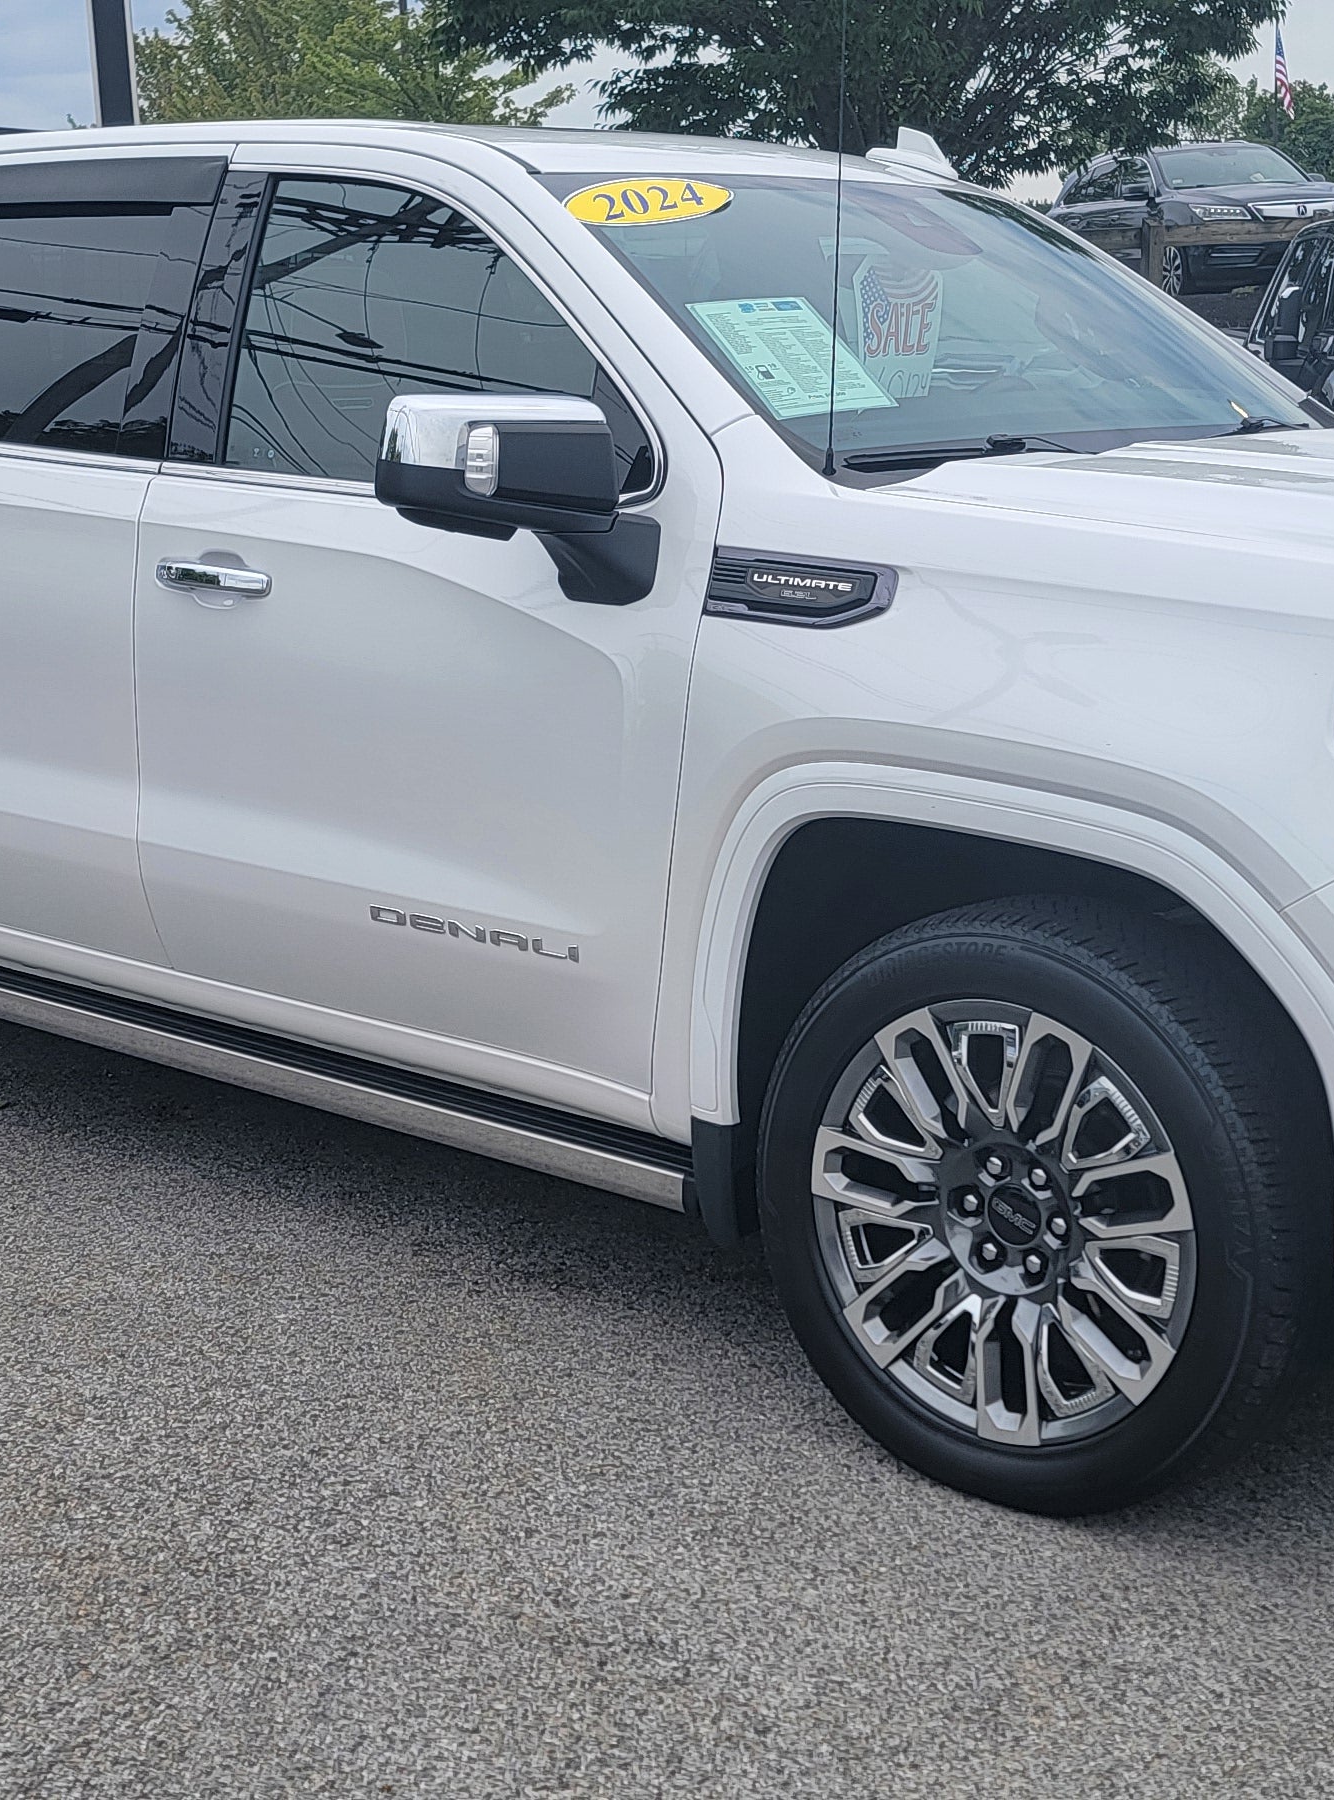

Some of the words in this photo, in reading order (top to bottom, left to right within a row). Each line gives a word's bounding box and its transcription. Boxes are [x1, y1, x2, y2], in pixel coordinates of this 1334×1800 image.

[593, 183, 704, 221] 2024
[867, 301, 936, 358] SALE
[753, 573, 853, 592] ULTIMATE
[369, 903, 579, 964] DENALI
[992, 1197, 1037, 1235] GMC
